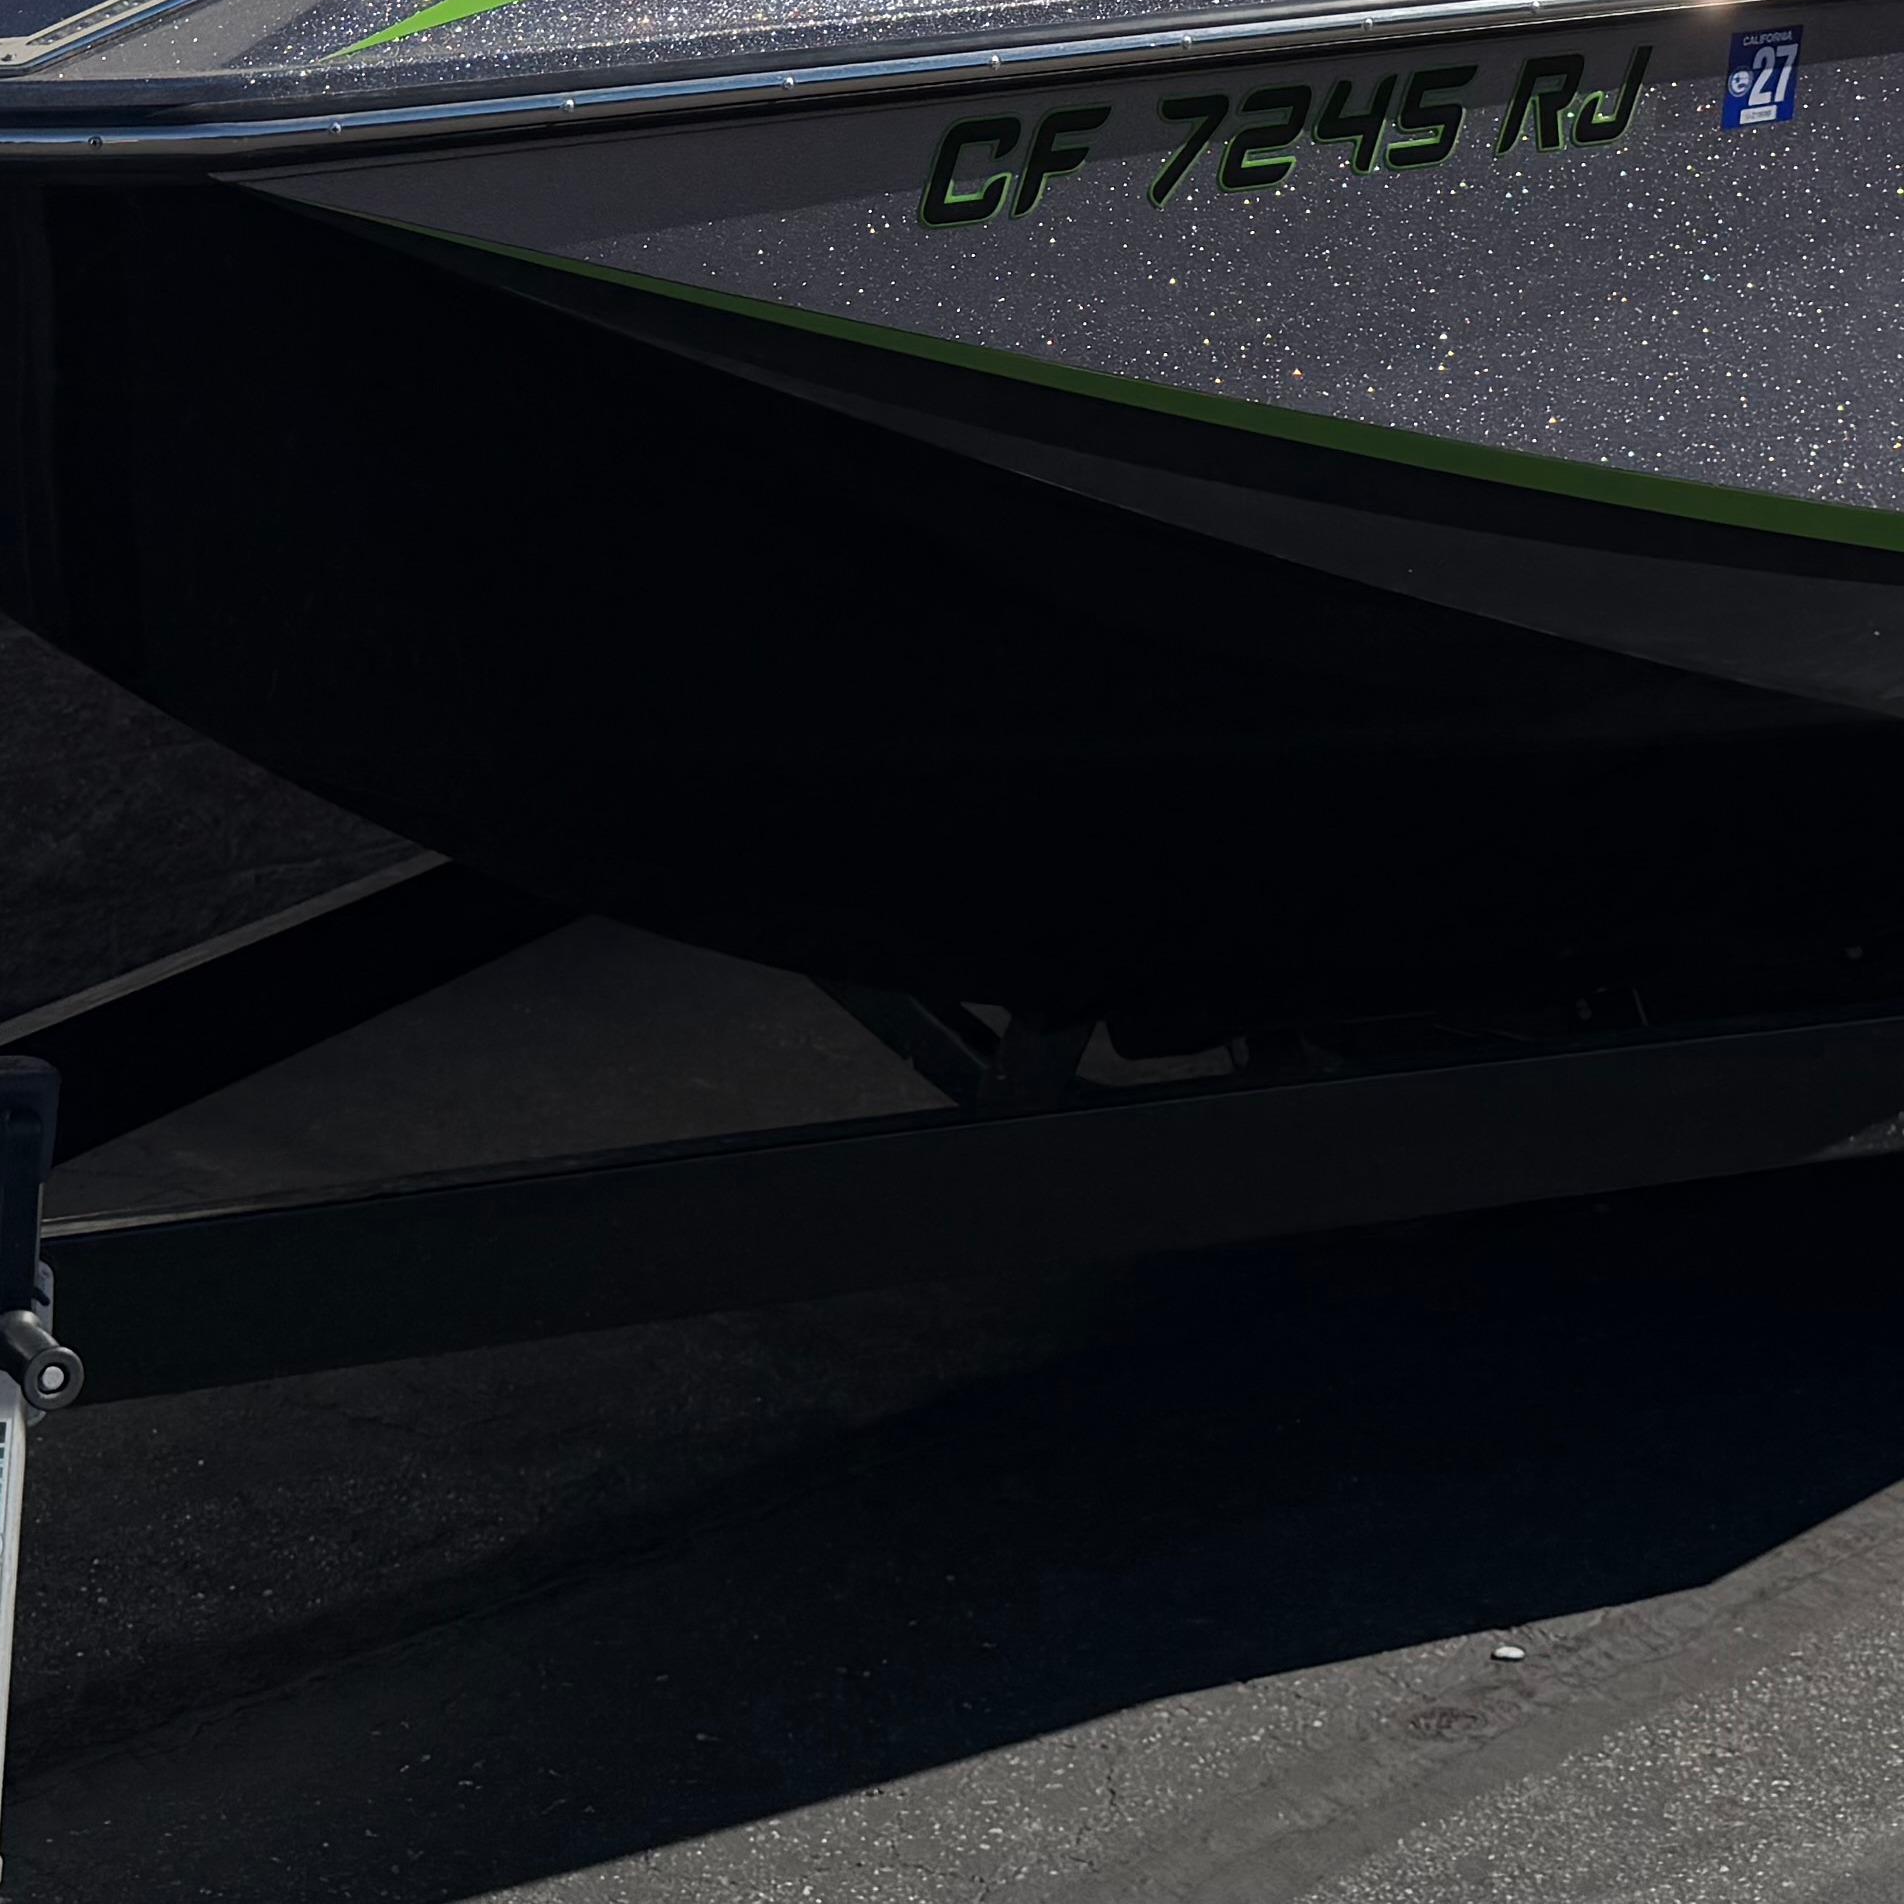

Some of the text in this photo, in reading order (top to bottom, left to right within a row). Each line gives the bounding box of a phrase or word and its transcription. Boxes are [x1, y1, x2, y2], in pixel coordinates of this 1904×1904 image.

[1744, 31, 1793, 46] CALIFORNIA
[1748, 43, 1799, 107] 27
[918, 44, 1652, 230] CF 7245 RJ
